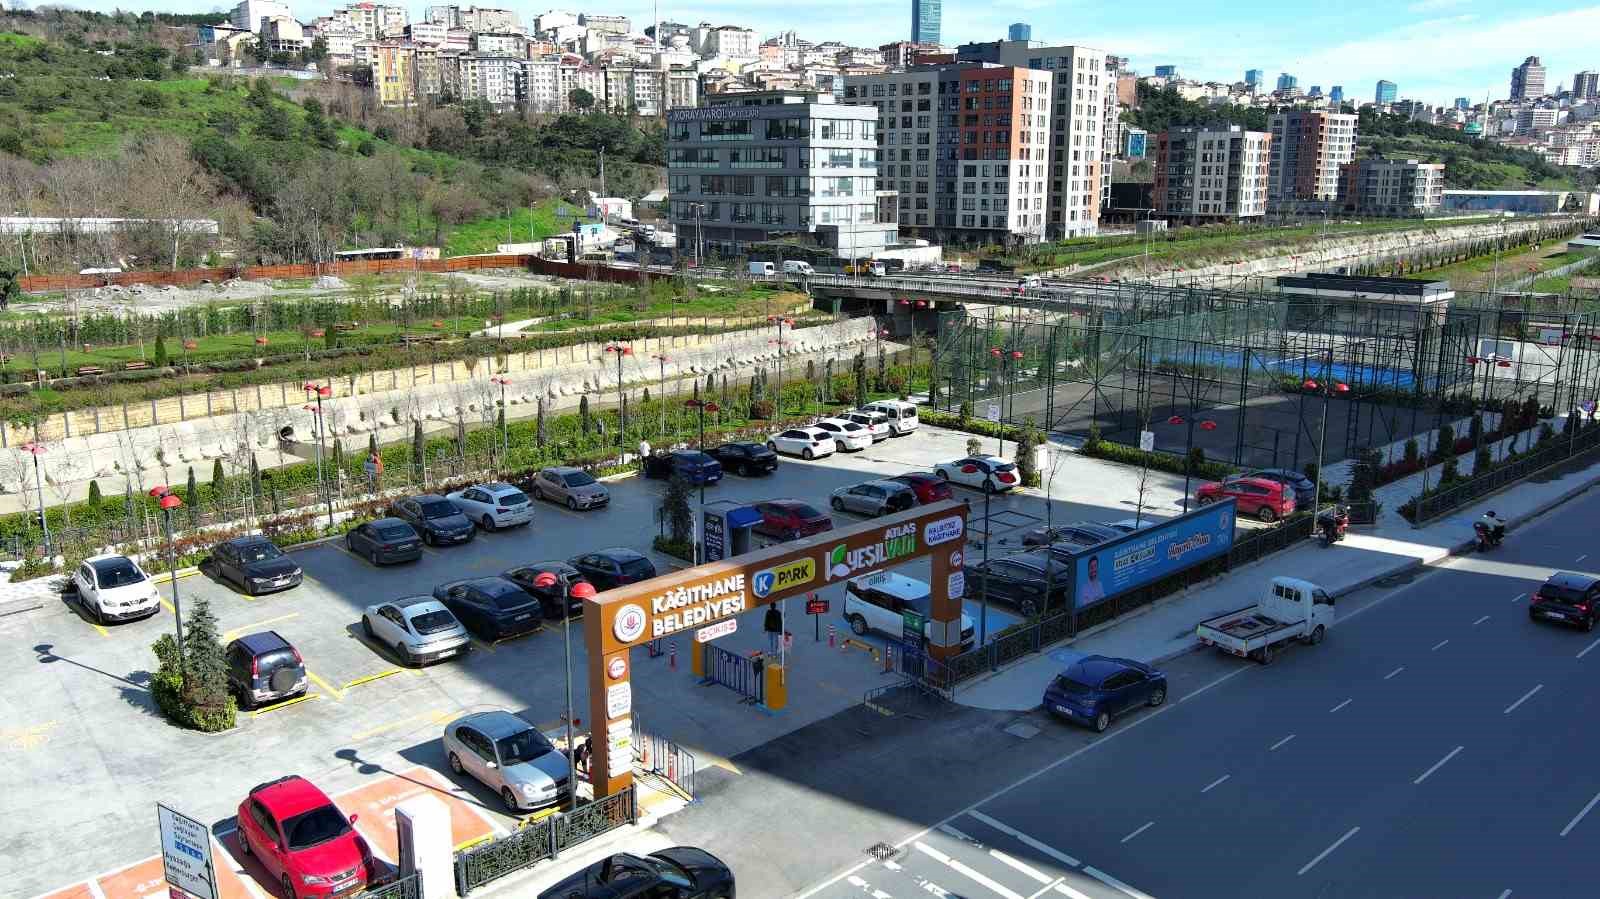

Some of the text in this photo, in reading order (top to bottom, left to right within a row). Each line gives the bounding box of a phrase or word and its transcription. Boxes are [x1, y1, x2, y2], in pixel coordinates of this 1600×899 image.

[652, 573, 745, 614] KÂĞITHANE
[777, 564, 809, 586] PARK
[653, 591, 745, 637] BELEDİYESİ
